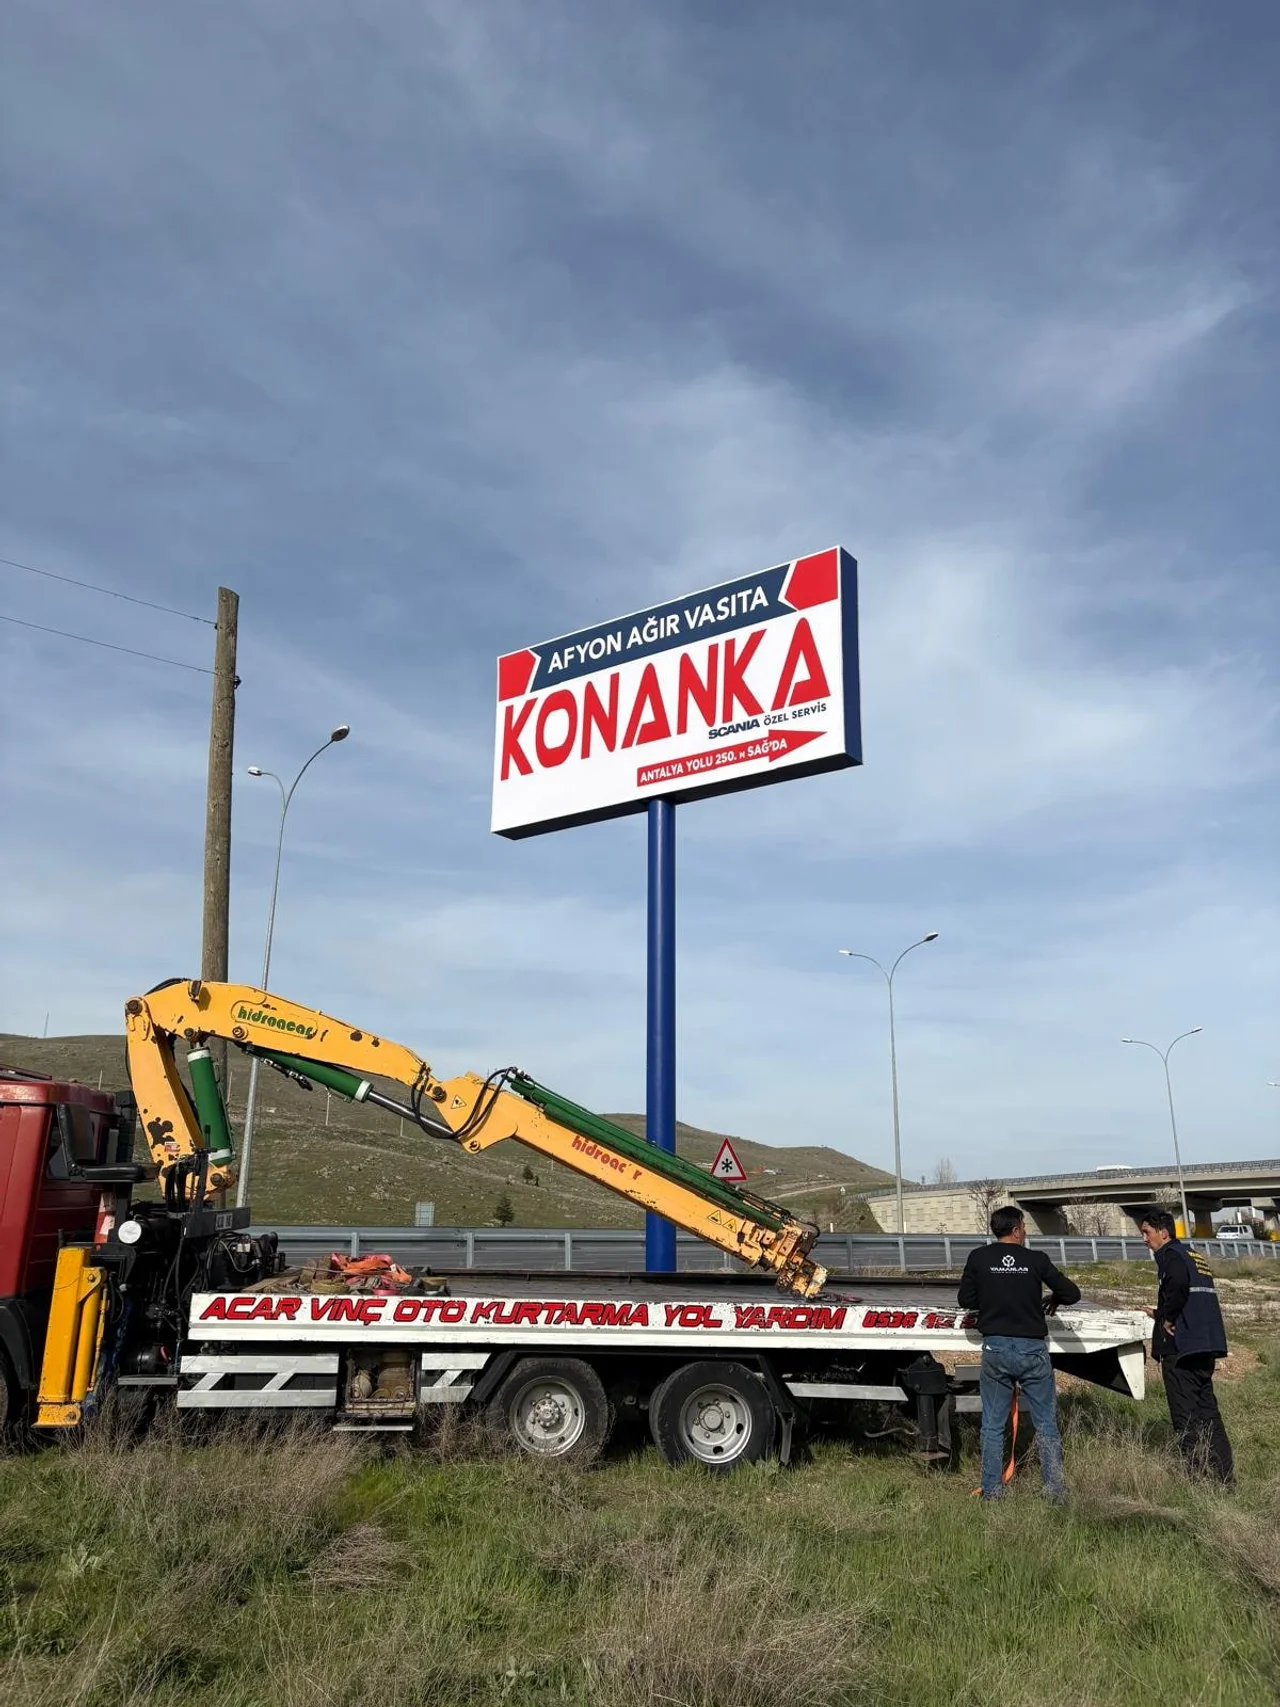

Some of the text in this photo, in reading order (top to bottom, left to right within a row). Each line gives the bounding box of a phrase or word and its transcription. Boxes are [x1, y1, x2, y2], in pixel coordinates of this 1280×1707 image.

[547, 585, 770, 674] AFYON AĞIR VASITA
[500, 616, 832, 781] KONANKA
[708, 701, 827, 740] SCANIA ÖZEL SERVİS
[640, 763, 684, 783] ANTALYA
[686, 756, 713, 774] YOLU
[715, 751, 737, 767] 250.
[571, 1134, 642, 1180] hidroacr
[199, 1297, 302, 1320] ACAR
[393, 1299, 466, 1323] OTO
[469, 1301, 649, 1326] KURTARMA
[664, 1304, 722, 1328] YOL
[733, 1306, 848, 1330] YARDIM
